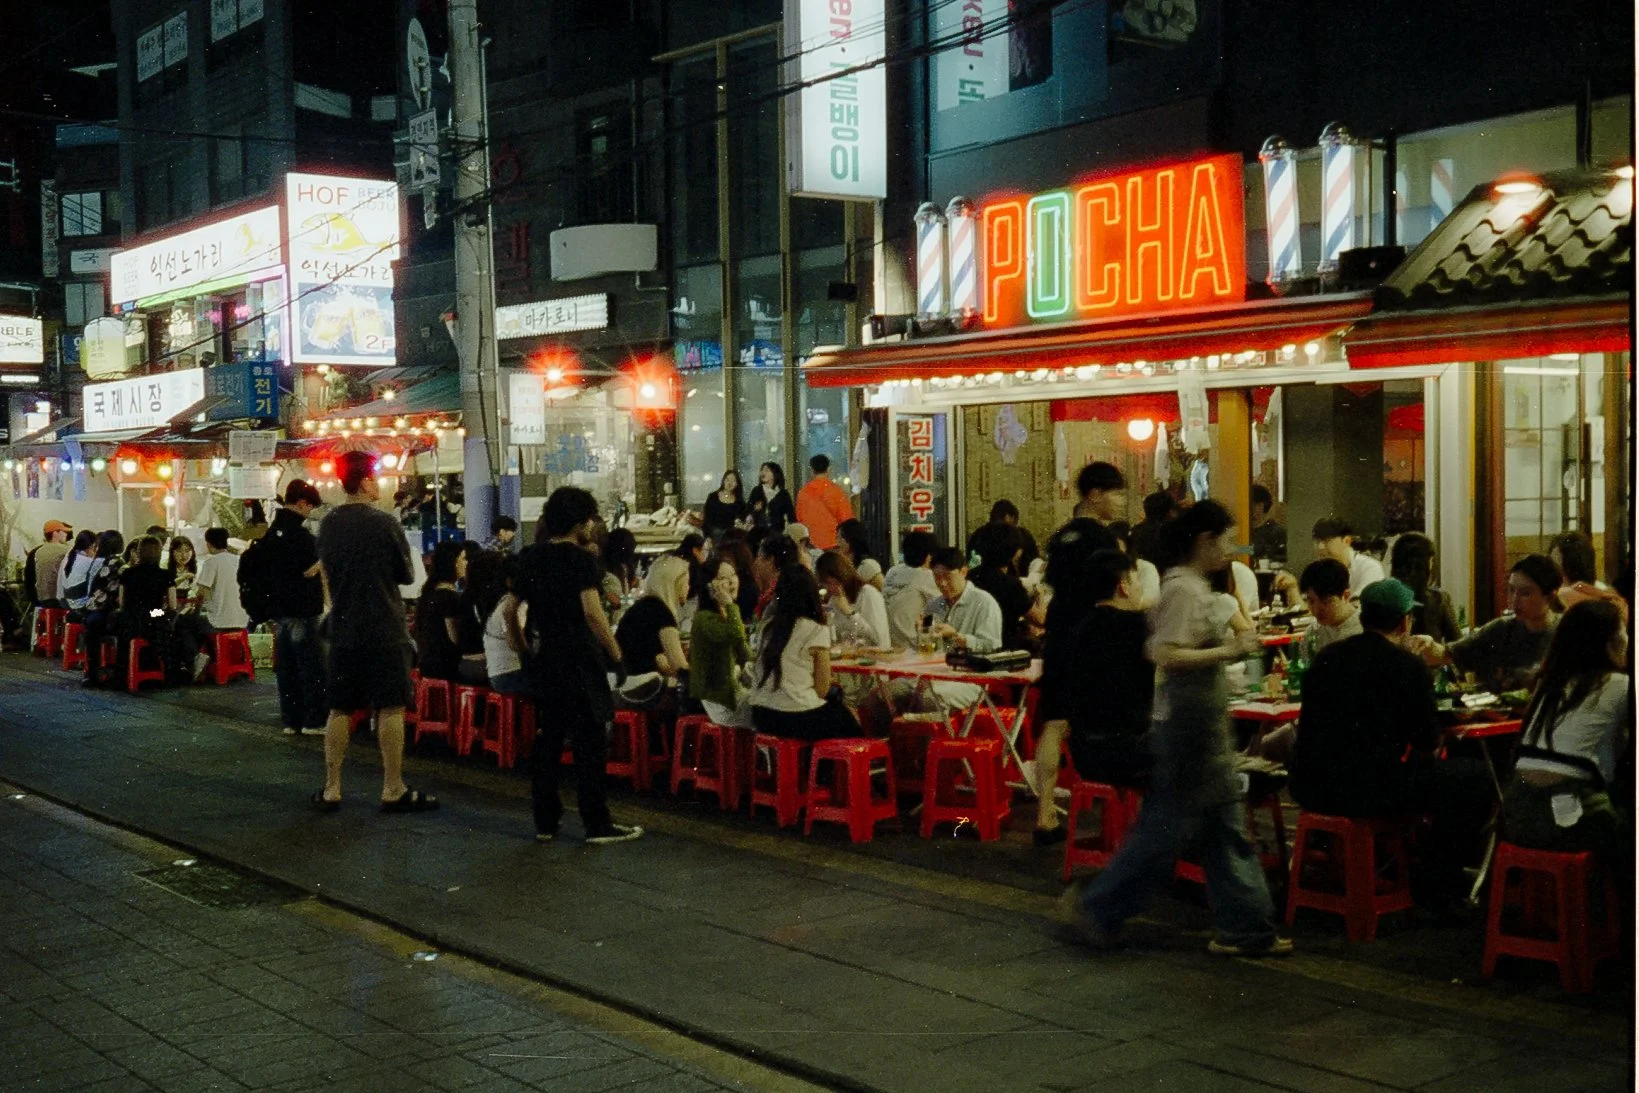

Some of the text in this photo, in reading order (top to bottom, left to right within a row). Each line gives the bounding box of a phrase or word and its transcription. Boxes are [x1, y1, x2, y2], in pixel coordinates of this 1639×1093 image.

[297, 183, 350, 206] HOF
[358, 187, 395, 200] BEER
[983, 163, 1231, 323] POCHA
[150, 241, 223, 286] 익선노가리
[525, 303, 578, 329] 마카로니
[366, 335, 393, 350] 2F
[94, 383, 162, 419] 국제시장
[254, 377, 272, 415] 전기
